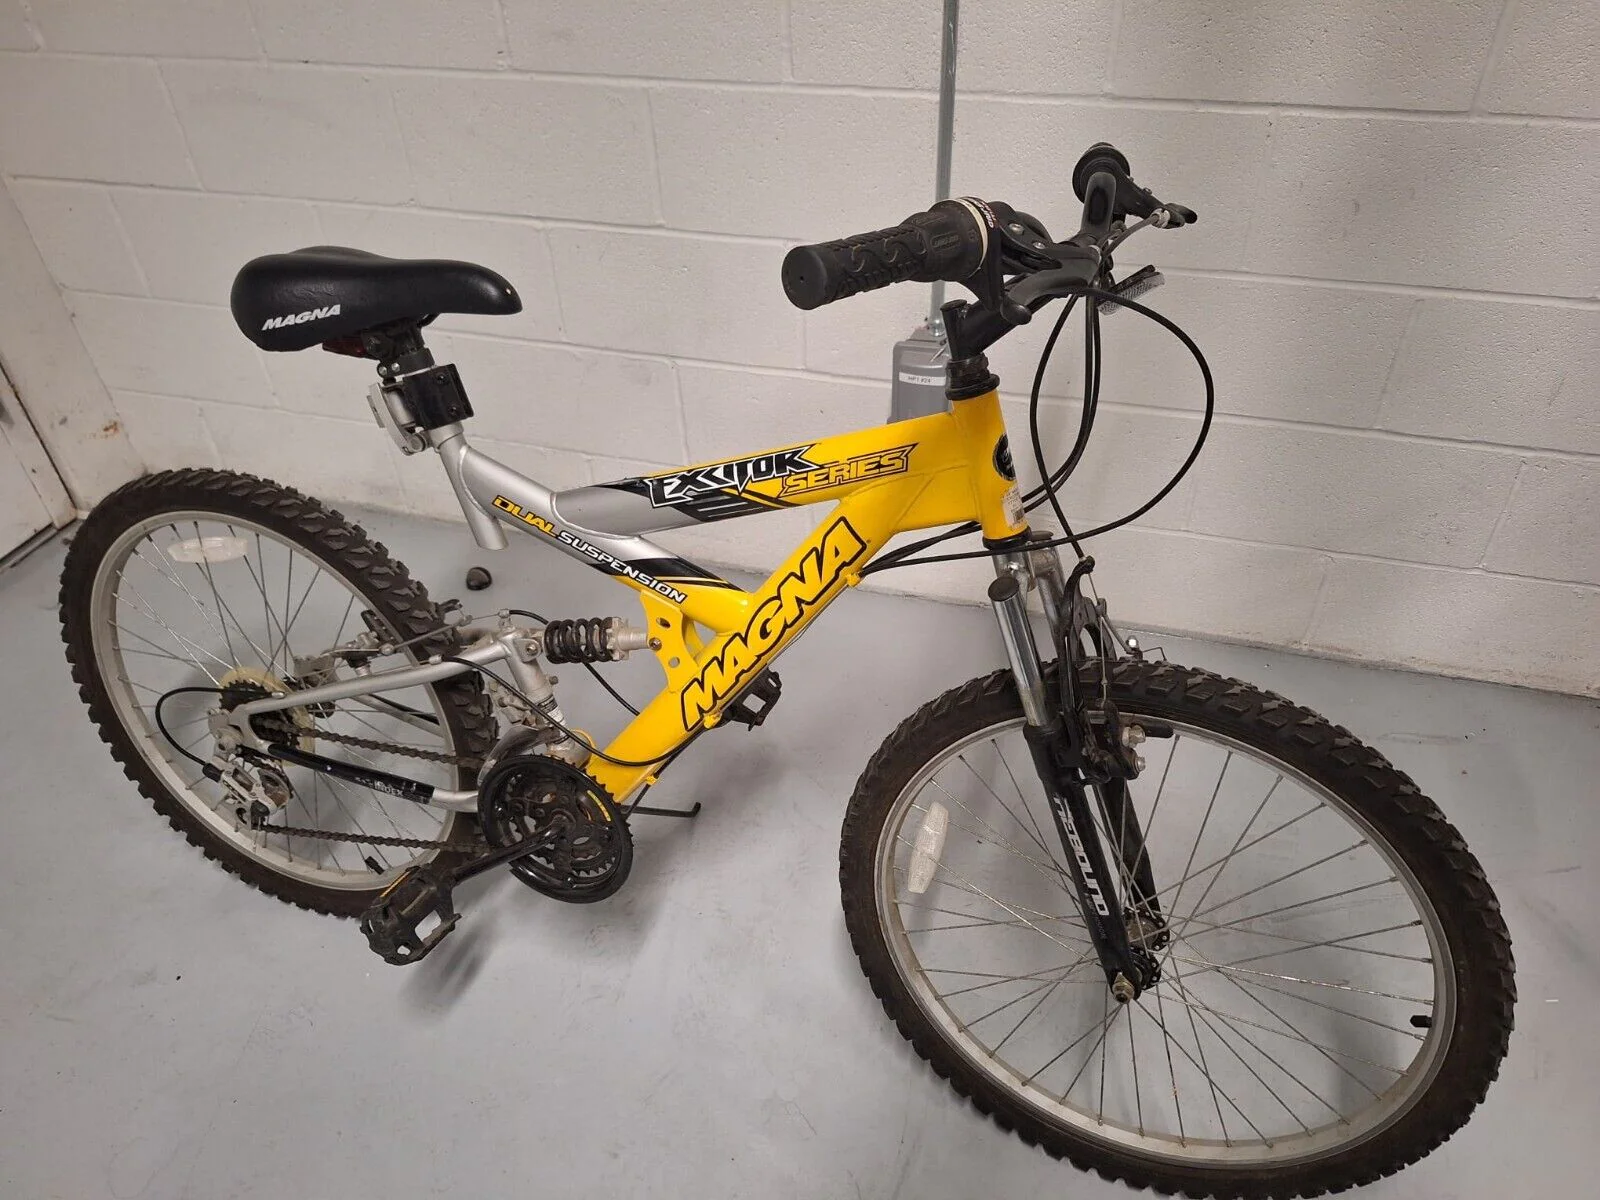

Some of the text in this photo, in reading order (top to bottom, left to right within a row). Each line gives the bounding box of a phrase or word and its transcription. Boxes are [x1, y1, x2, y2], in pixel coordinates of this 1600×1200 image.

[261, 304, 341, 331] MAGNA
[644, 444, 914, 507] EXCITOR SERIES
[492, 495, 688, 604] DUAL SUSPENSION
[681, 516, 867, 731] MAGNA
